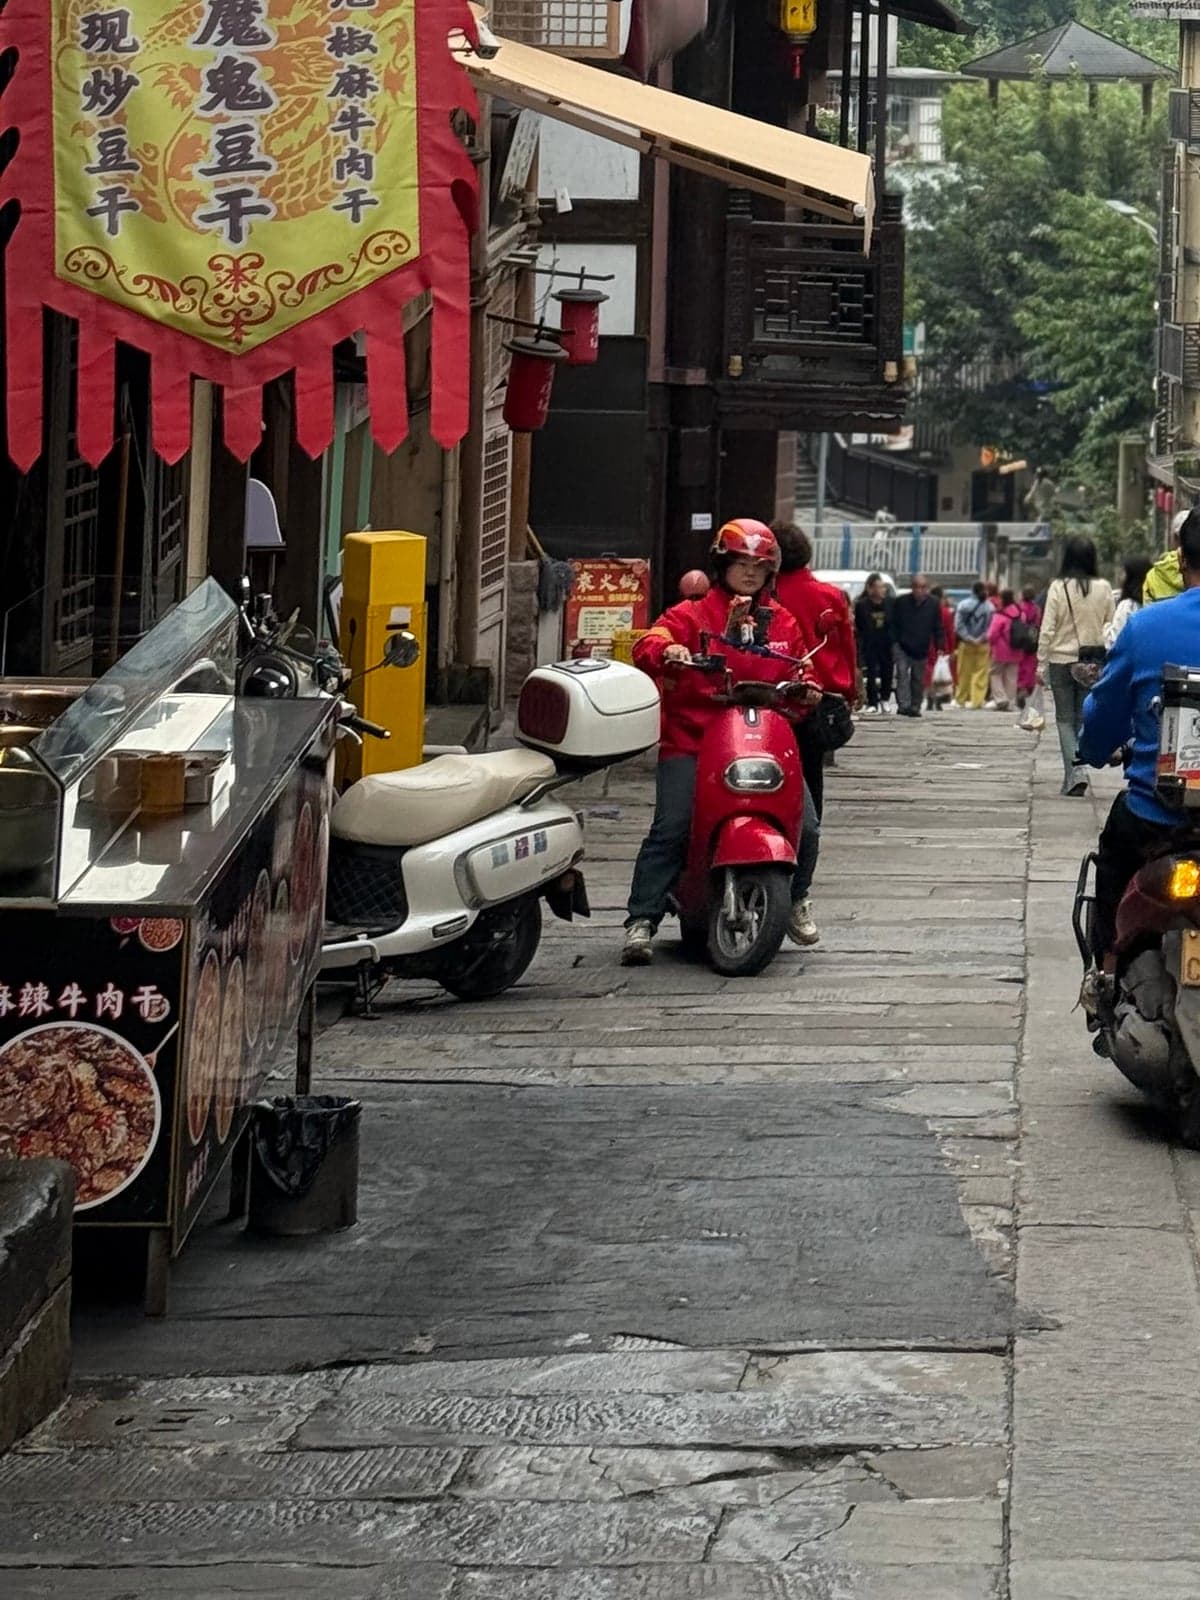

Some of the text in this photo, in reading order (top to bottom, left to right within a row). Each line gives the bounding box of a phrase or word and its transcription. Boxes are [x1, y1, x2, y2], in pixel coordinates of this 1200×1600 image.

[326, 26, 379, 224] 椒麻牛肉干
